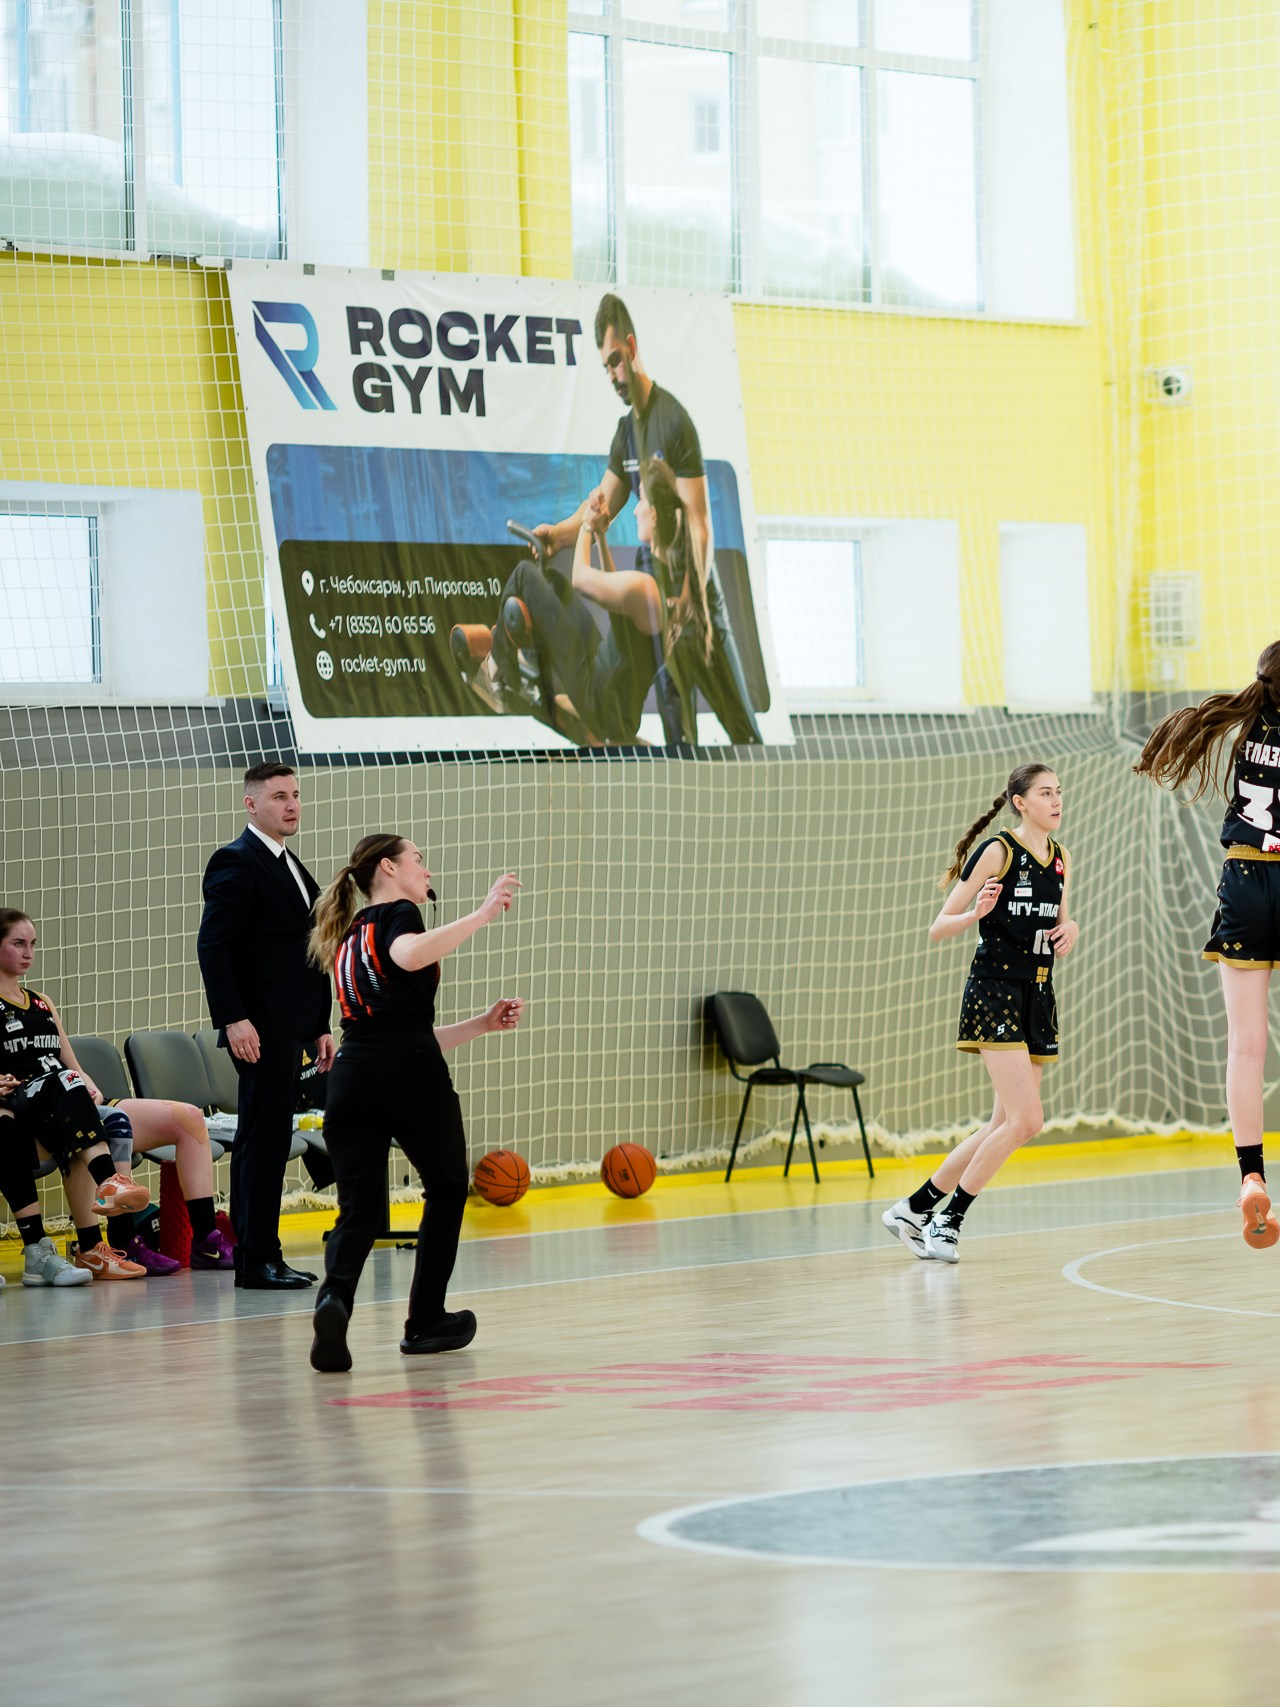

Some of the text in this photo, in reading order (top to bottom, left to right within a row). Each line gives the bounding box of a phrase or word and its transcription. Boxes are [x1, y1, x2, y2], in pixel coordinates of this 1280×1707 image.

[345, 306, 583, 366] ROCKET
[352, 362, 486, 417] GYM
[319, 575, 501, 599] г. Чебоксары, ул. Пирогова, 10
[329, 615, 436, 637] +7 (8352) 60 65 56
[340, 654, 426, 677] rocket-gym.ru
[1007, 901, 1060, 917] ЧГУ-АТЛА
